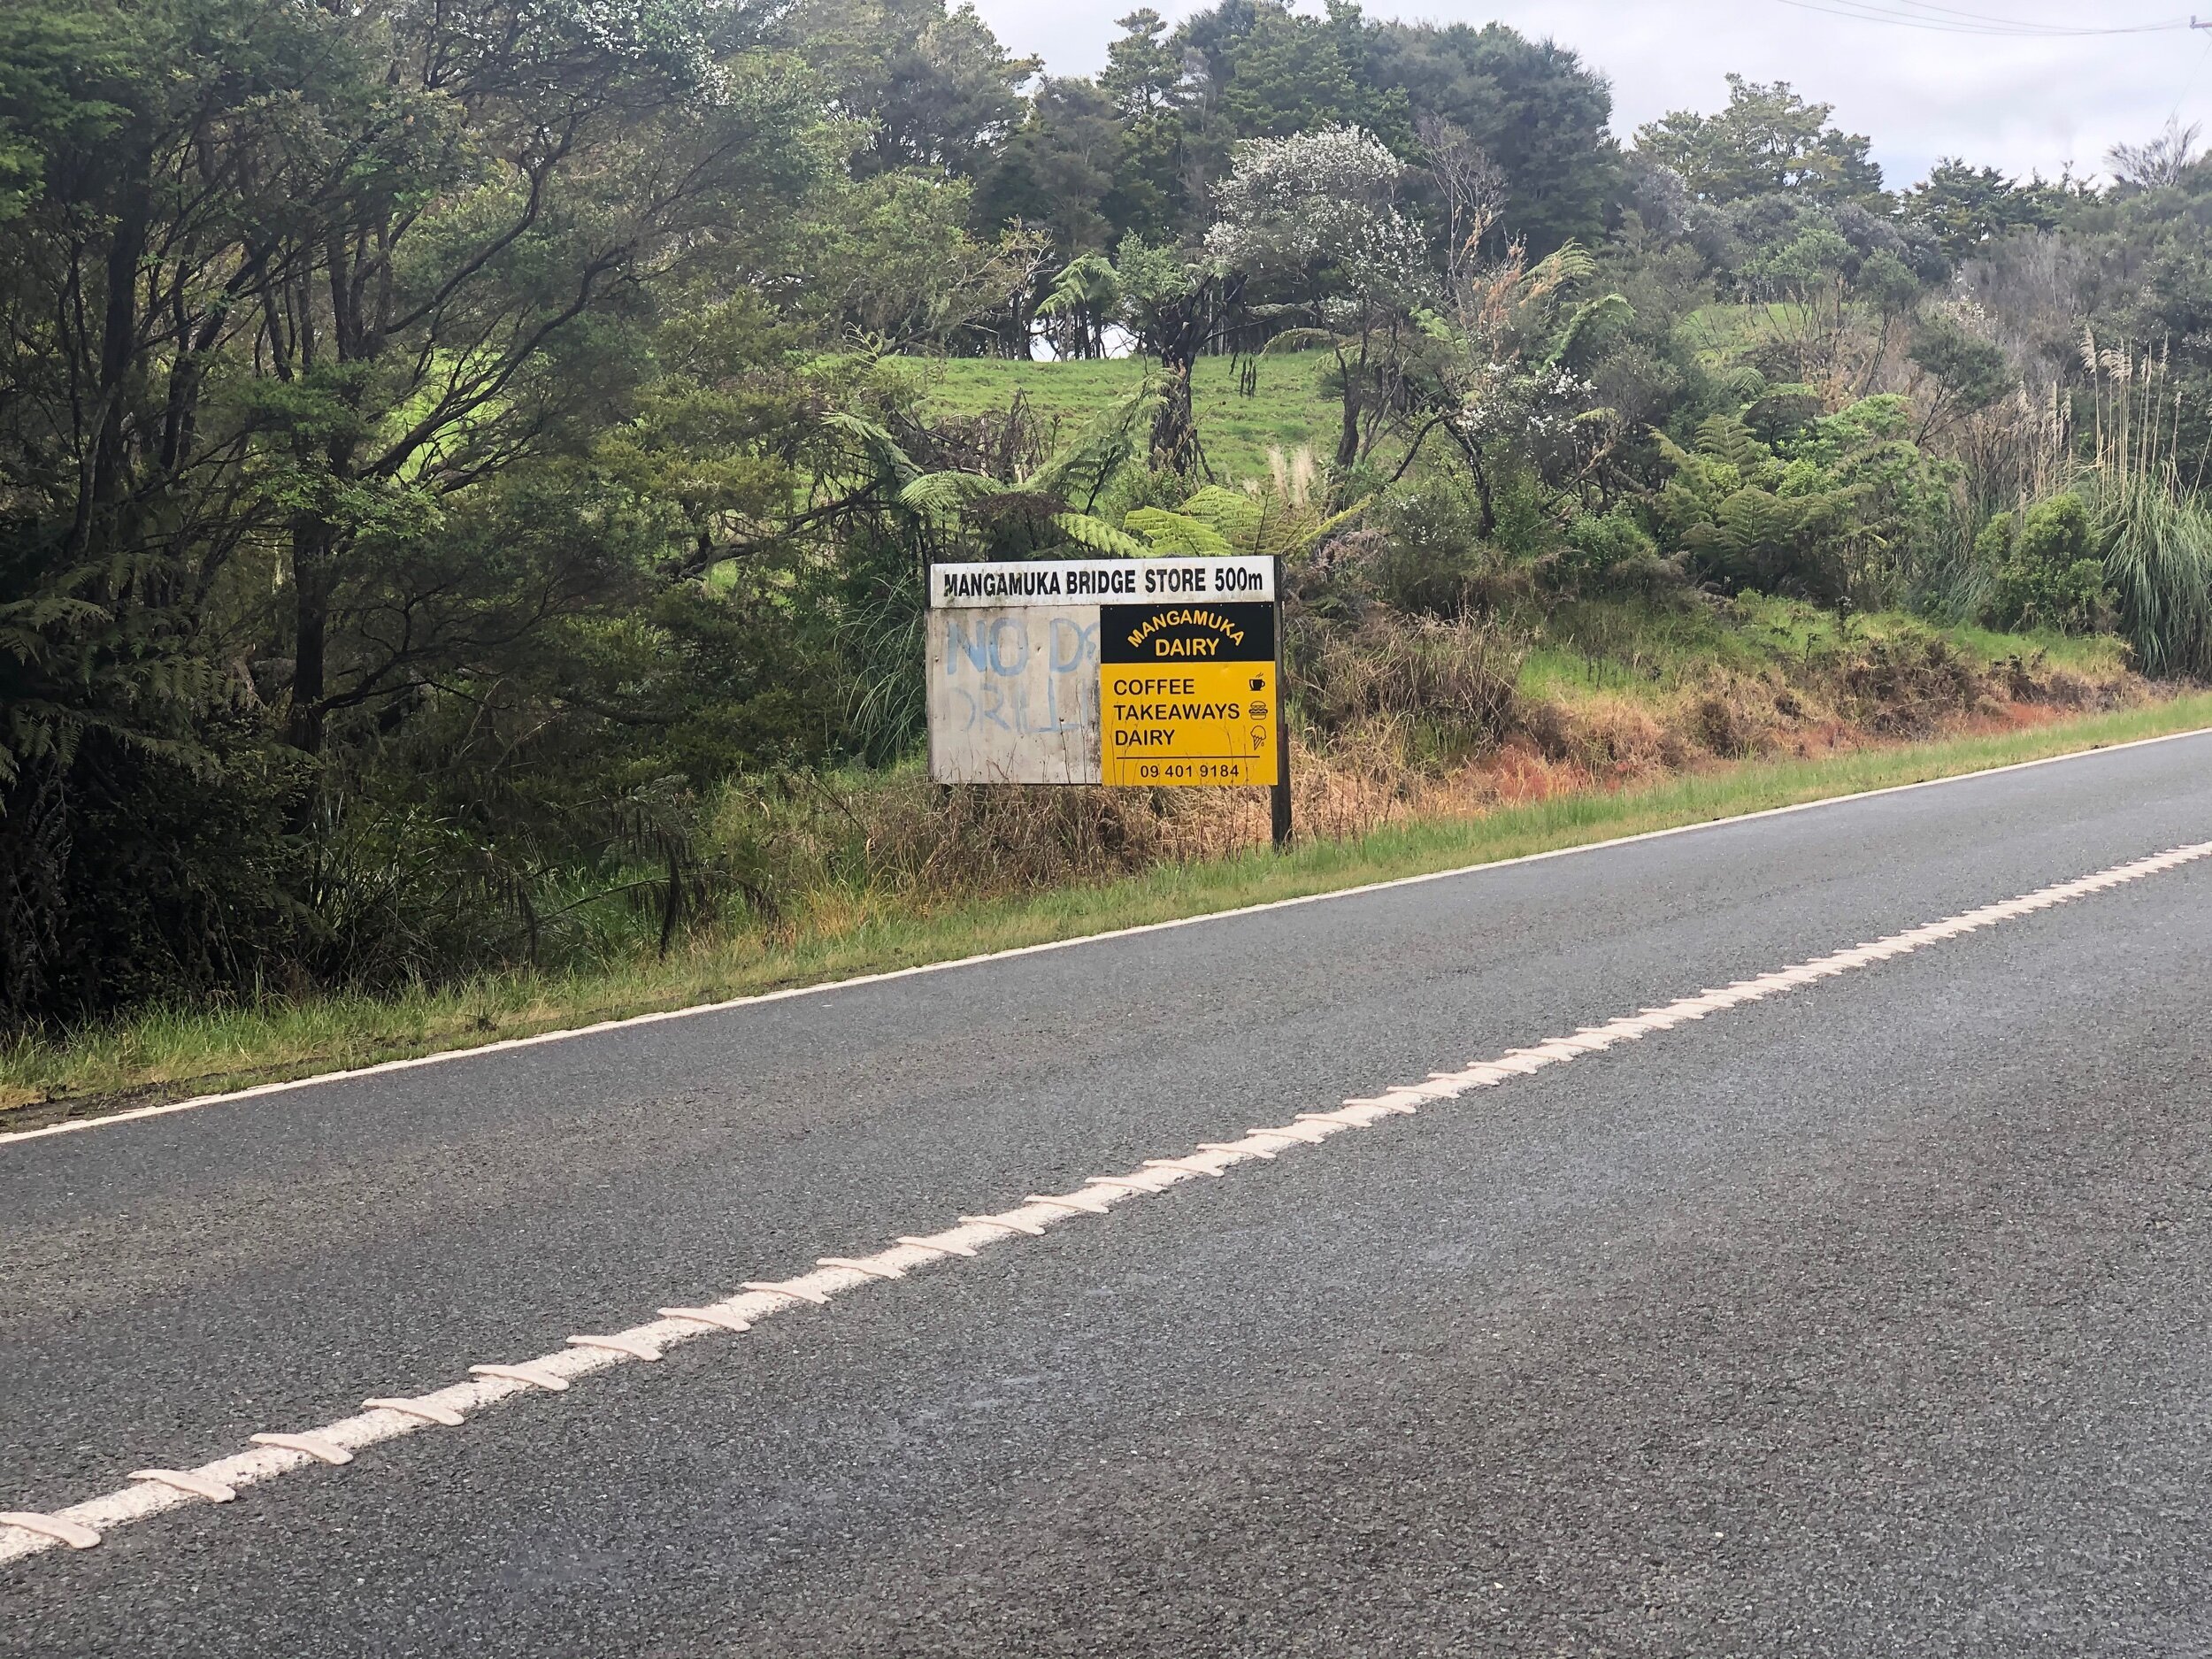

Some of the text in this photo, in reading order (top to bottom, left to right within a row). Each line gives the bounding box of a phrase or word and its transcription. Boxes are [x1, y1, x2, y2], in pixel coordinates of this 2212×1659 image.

[944, 567, 1263, 597] MANGAMUKA BRIDGE STORE 500m
[1127, 609, 1246, 648] MANGAMUKA
[947, 617, 1028, 677] NO
[1156, 638, 1219, 657] DAIRY
[1113, 679, 1195, 695] COFFEE
[1113, 703, 1240, 721] TAKEAWAYS
[1115, 729, 1176, 746] DAIRY
[1140, 764, 1240, 778] 09 401 9184
